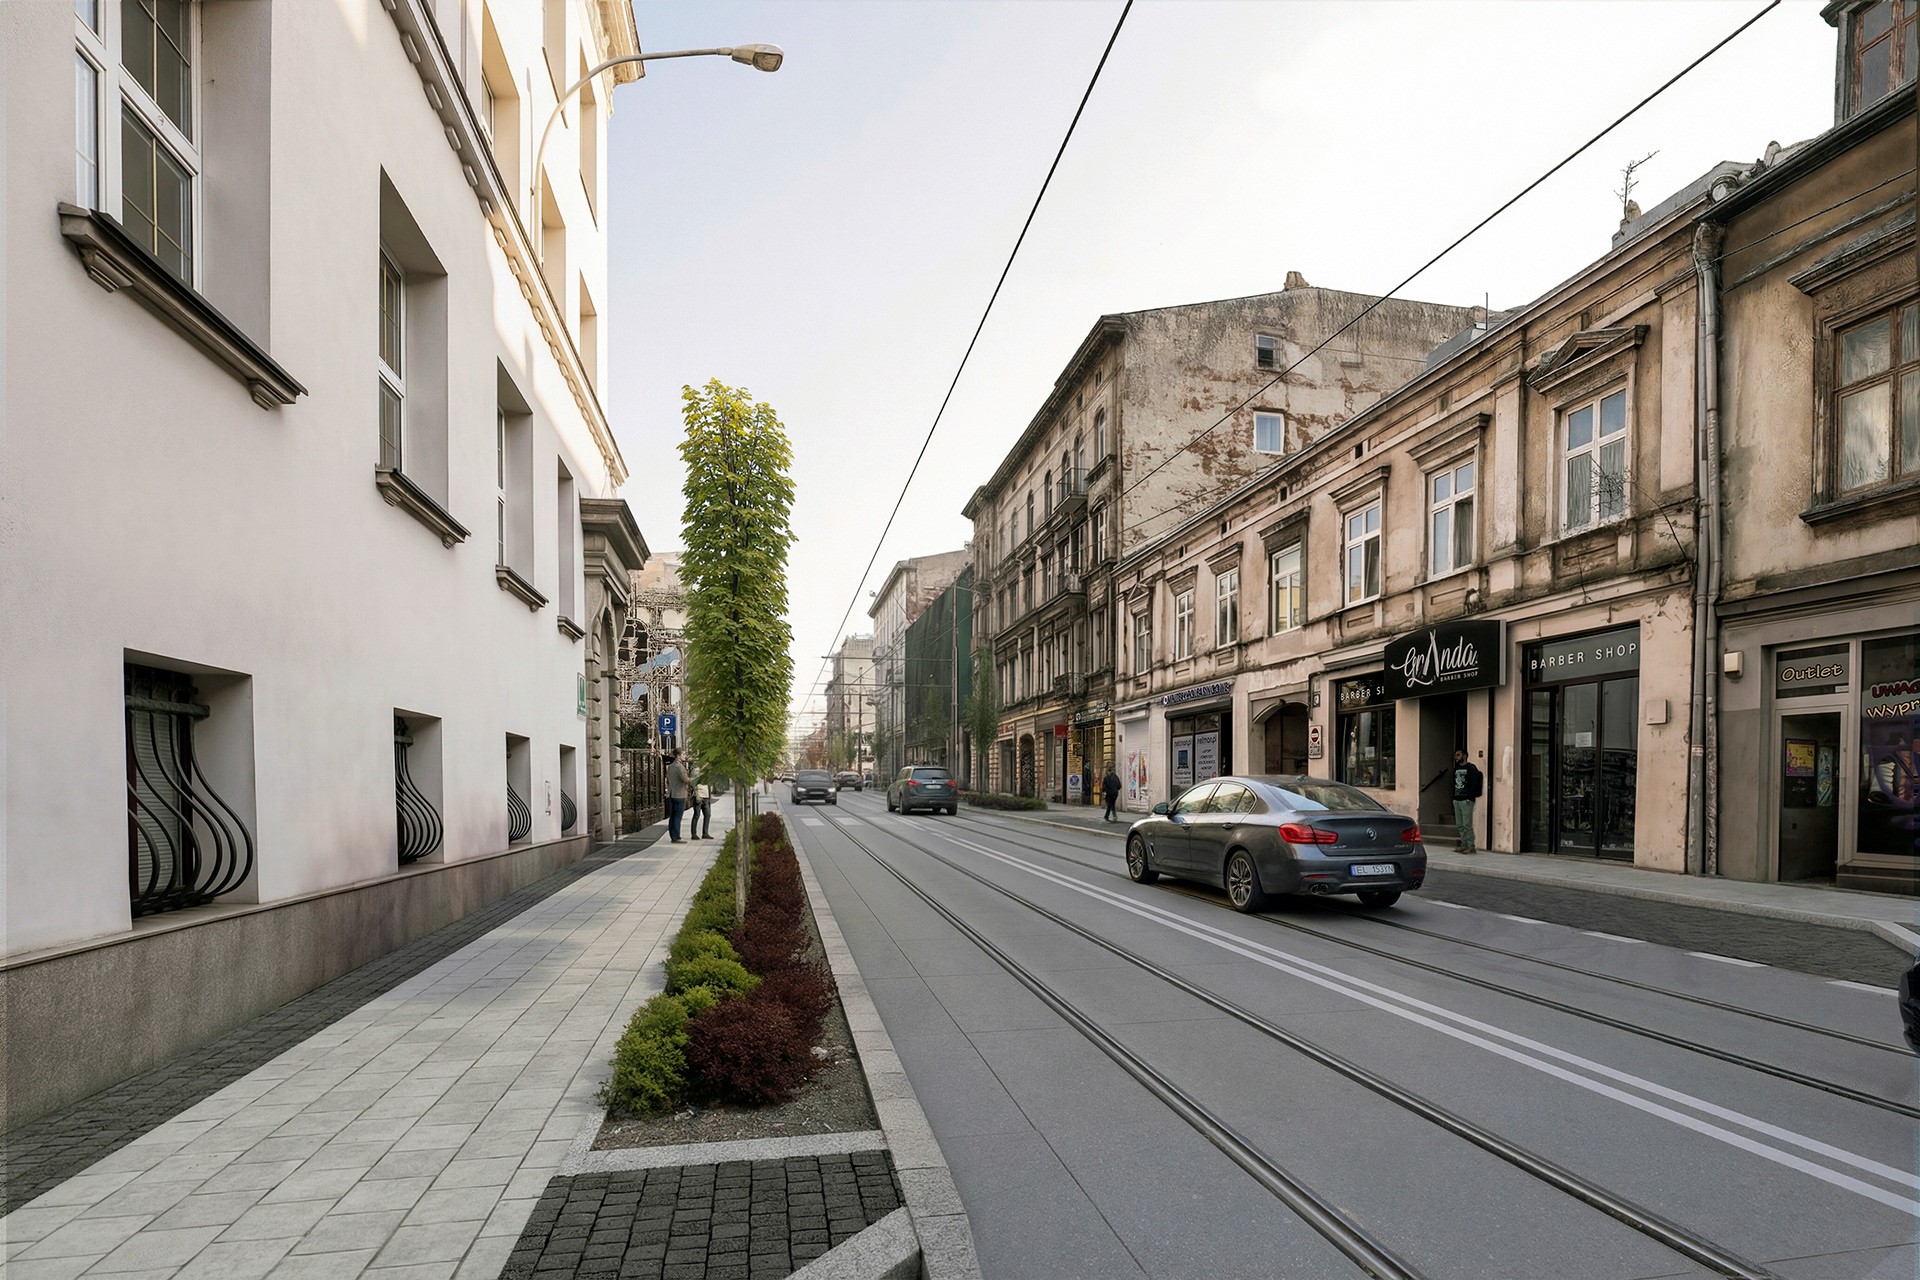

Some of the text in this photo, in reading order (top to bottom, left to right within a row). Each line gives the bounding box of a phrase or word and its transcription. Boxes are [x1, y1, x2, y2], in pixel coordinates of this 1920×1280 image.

[1531, 643, 1637, 670] BARBER SHOP
[1440, 671, 1478, 682] BARBER SHOP
[1781, 664, 1843, 682] Outlet
[1340, 686, 1384, 701] BARBER S
[1866, 698, 1920, 718] Wypr
[664, 717, 671, 726] P
[1356, 866, 1368, 874] EL
